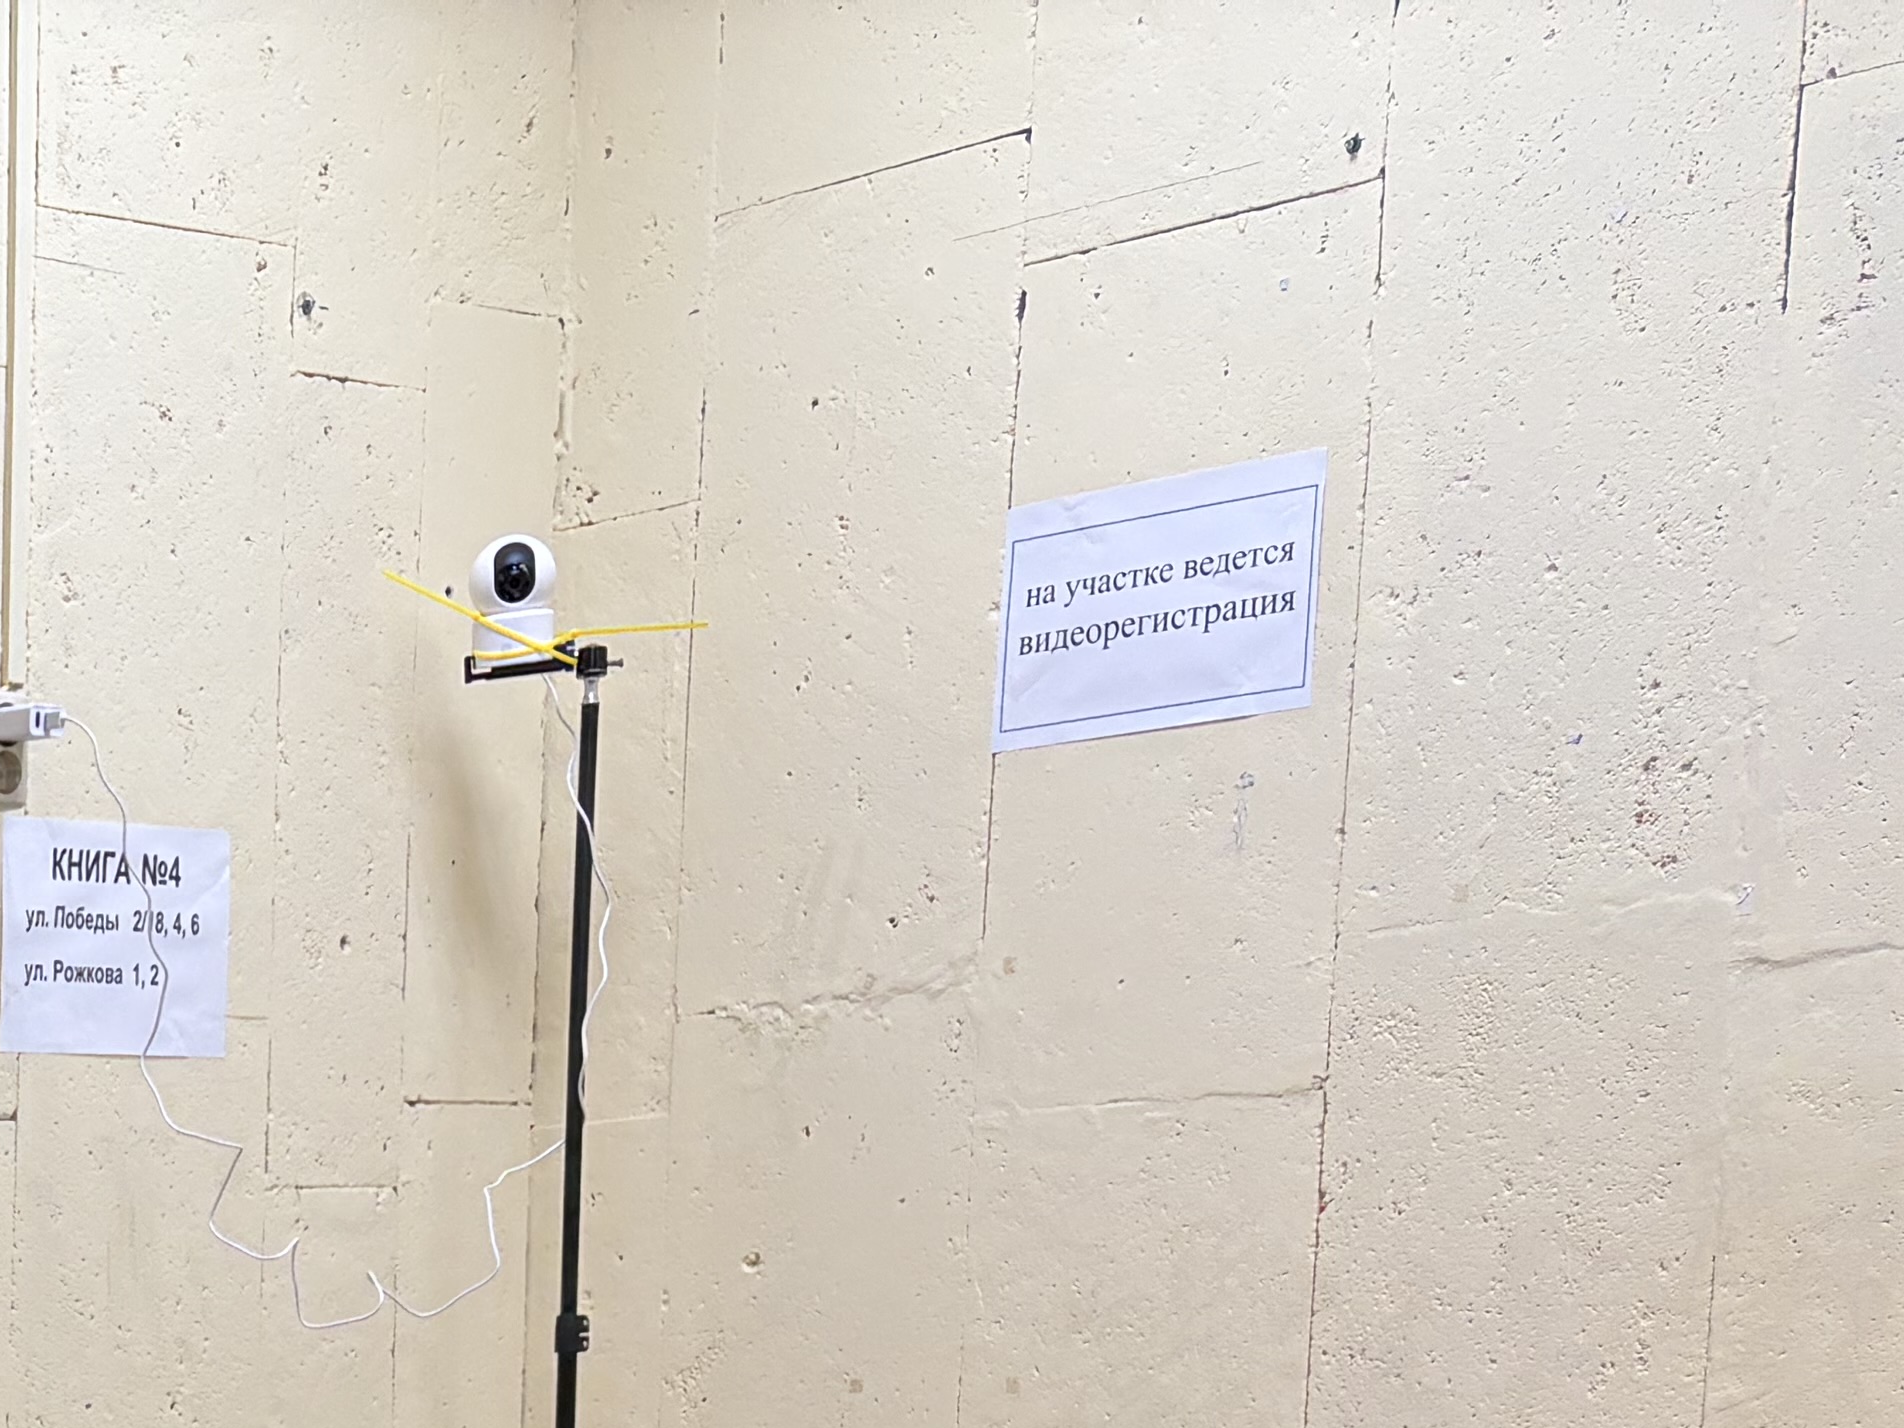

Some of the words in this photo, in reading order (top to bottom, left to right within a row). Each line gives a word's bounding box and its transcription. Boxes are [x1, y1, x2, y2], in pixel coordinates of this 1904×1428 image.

[1026, 584, 1055, 608] на
[1063, 563, 1174, 608] участке
[1184, 541, 1295, 580] ведется
[1018, 589, 1297, 656] видеорегистрация
[52, 847, 131, 885] КНИГА
[141, 853, 182, 888] №4
[25, 909, 49, 935] ул.
[54, 905, 119, 934] Победы
[172, 913, 186, 939] 4,
[191, 913, 200, 936] 6
[24, 963, 48, 987] ул.
[53, 959, 123, 985] Рожкова
[133, 963, 145, 989] 1,
[150, 964, 159, 986] 2
